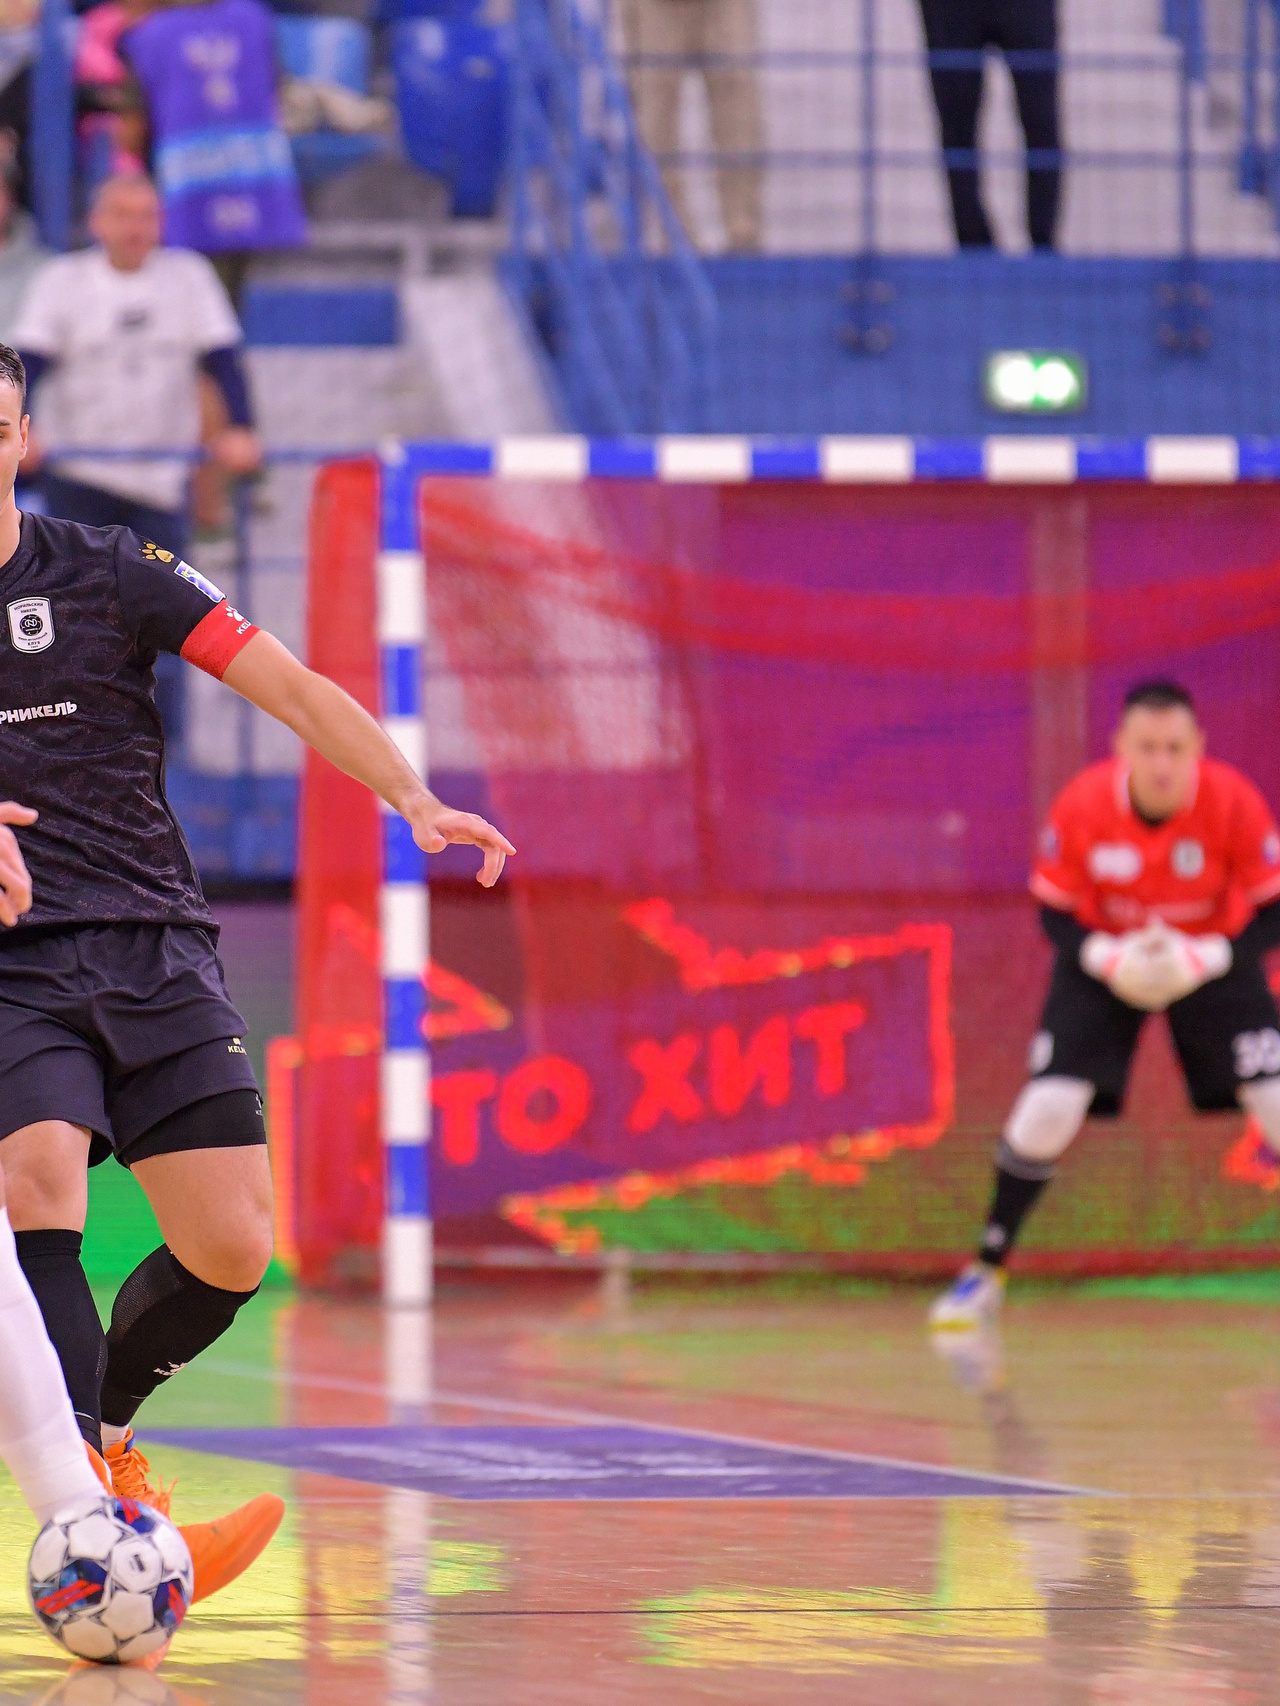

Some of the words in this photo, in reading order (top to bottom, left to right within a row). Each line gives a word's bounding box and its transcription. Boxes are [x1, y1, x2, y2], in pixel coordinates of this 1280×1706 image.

[236, 620, 252, 634] KEL
[430, 1054, 593, 1166] ТО
[629, 1002, 865, 1134] ХИТ
